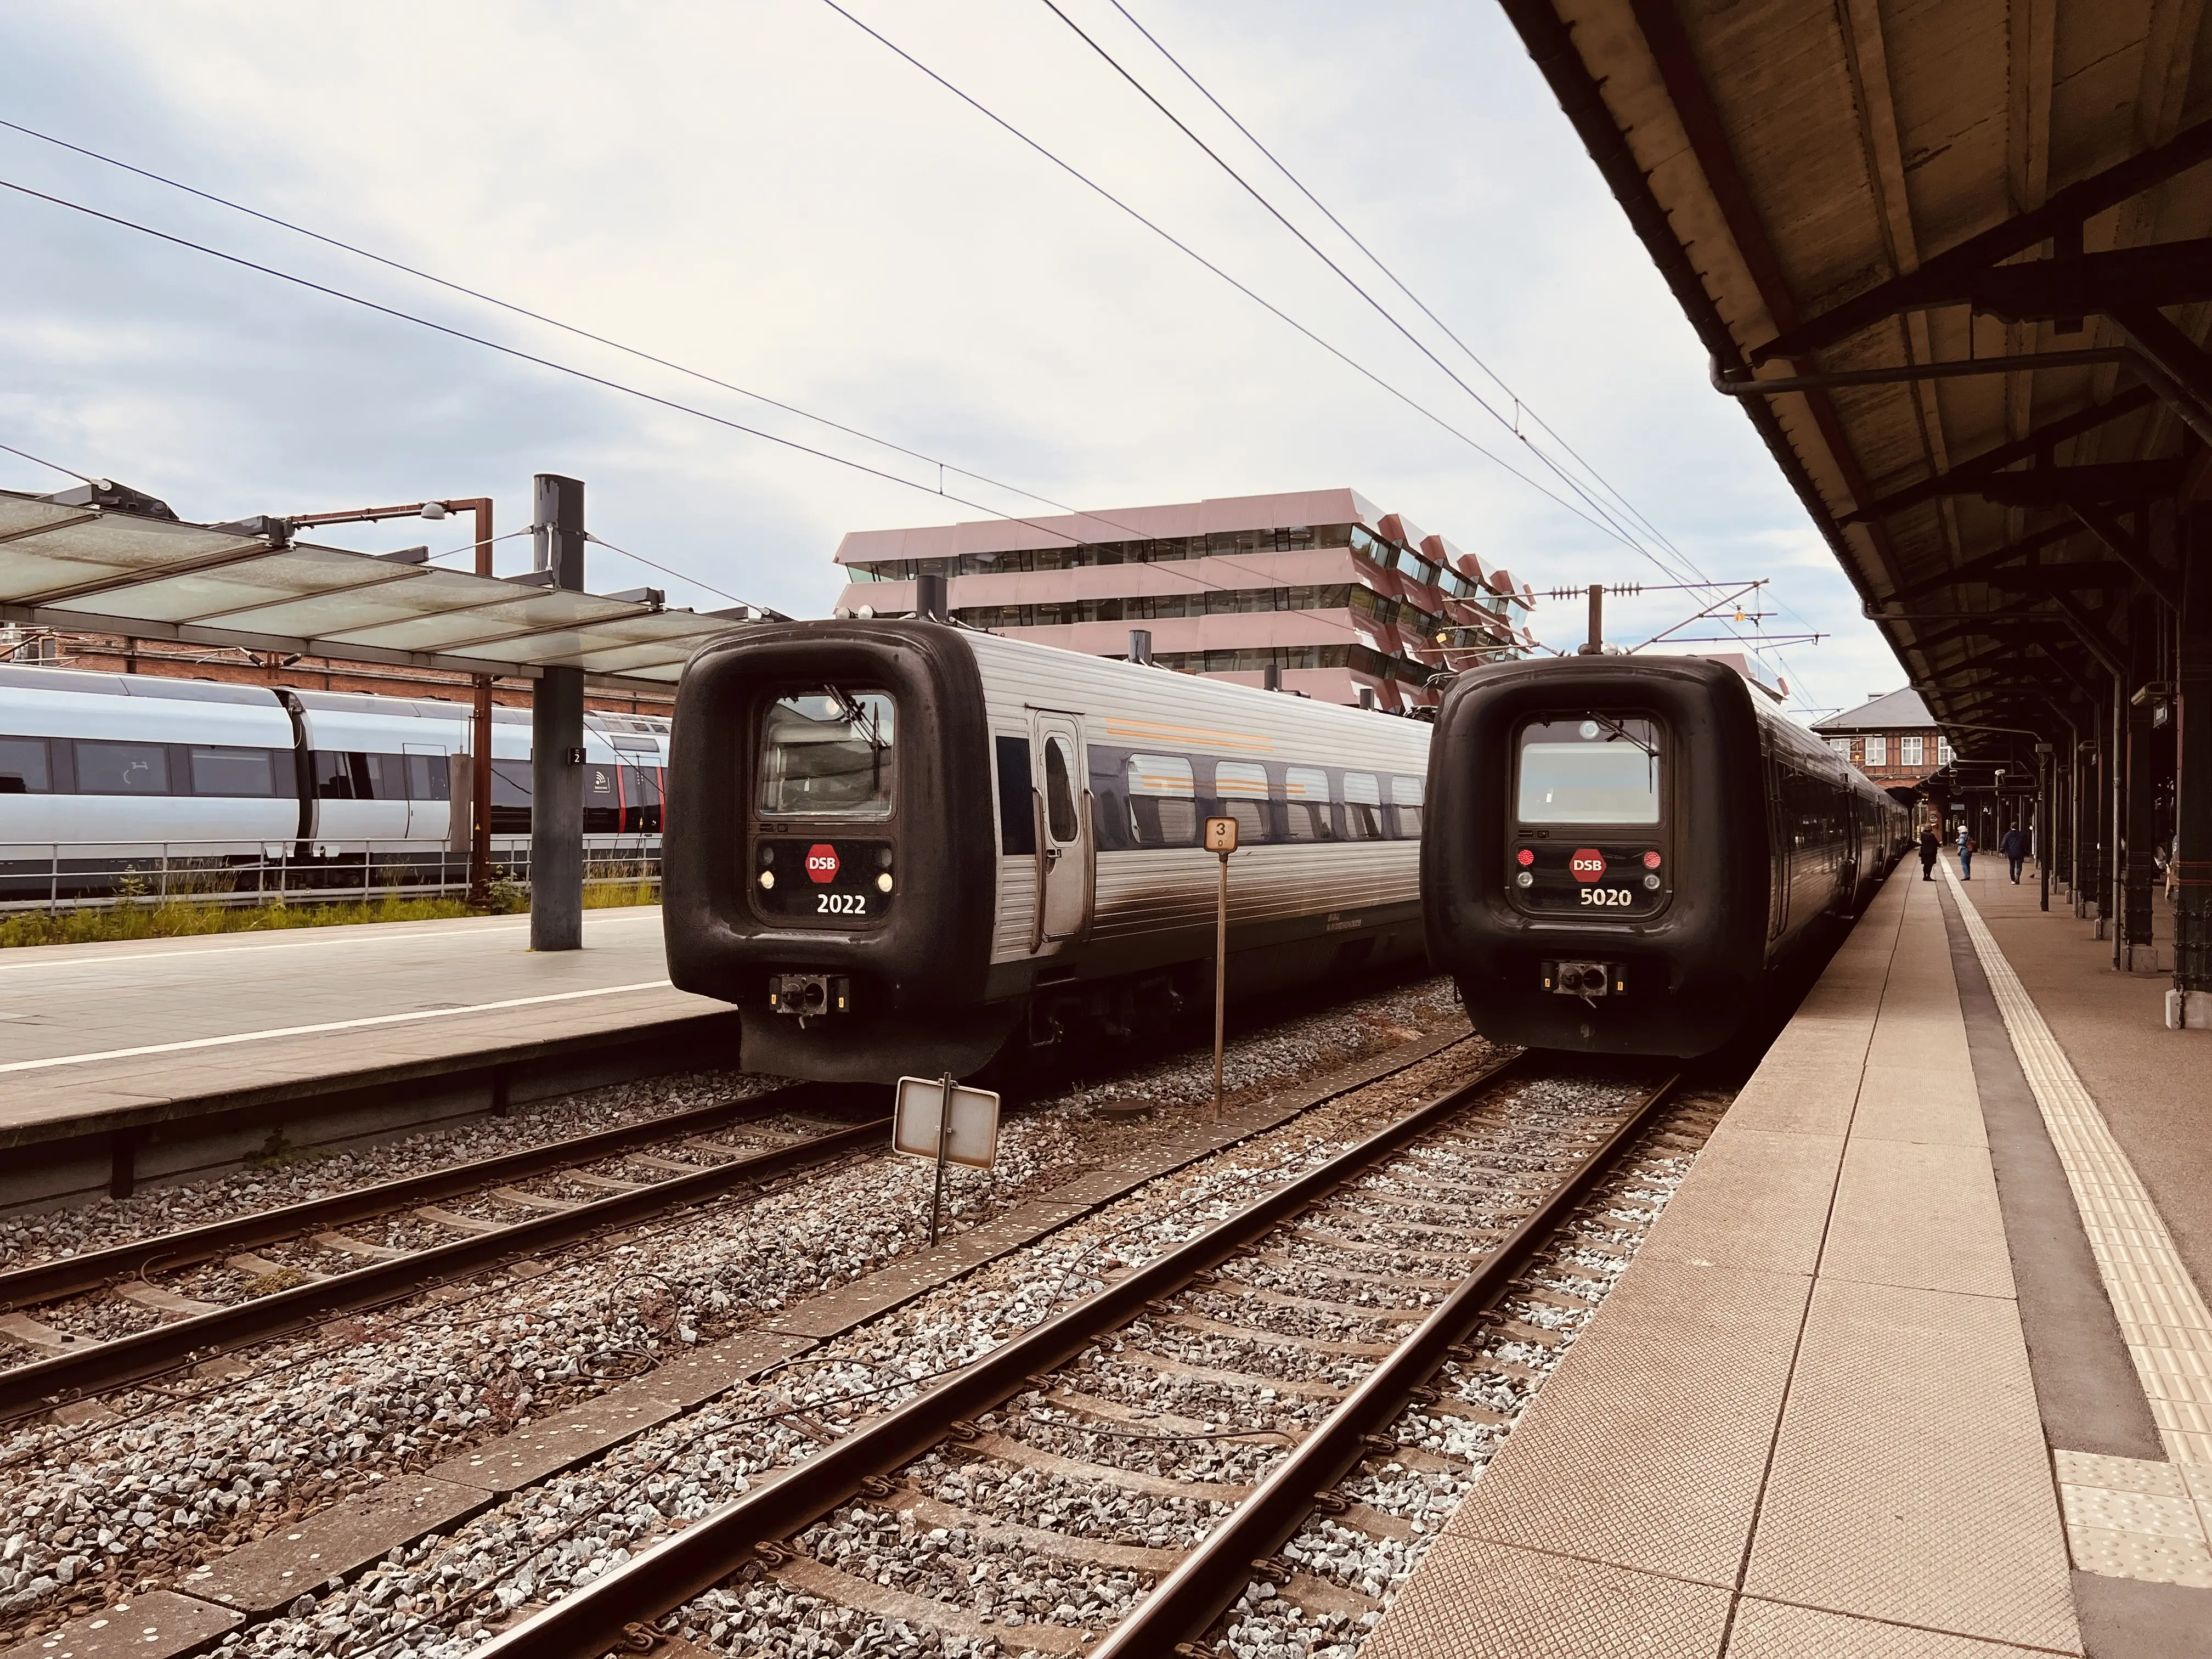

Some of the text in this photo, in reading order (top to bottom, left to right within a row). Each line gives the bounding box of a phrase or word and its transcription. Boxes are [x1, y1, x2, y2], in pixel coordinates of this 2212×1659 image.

[574, 754, 580, 763] 2
[1216, 822, 1226, 836] 3
[809, 857, 836, 870] DSB
[1573, 860, 1602, 871] DSB
[1581, 888, 1632, 906] 5020
[817, 894, 866, 915] 2022
